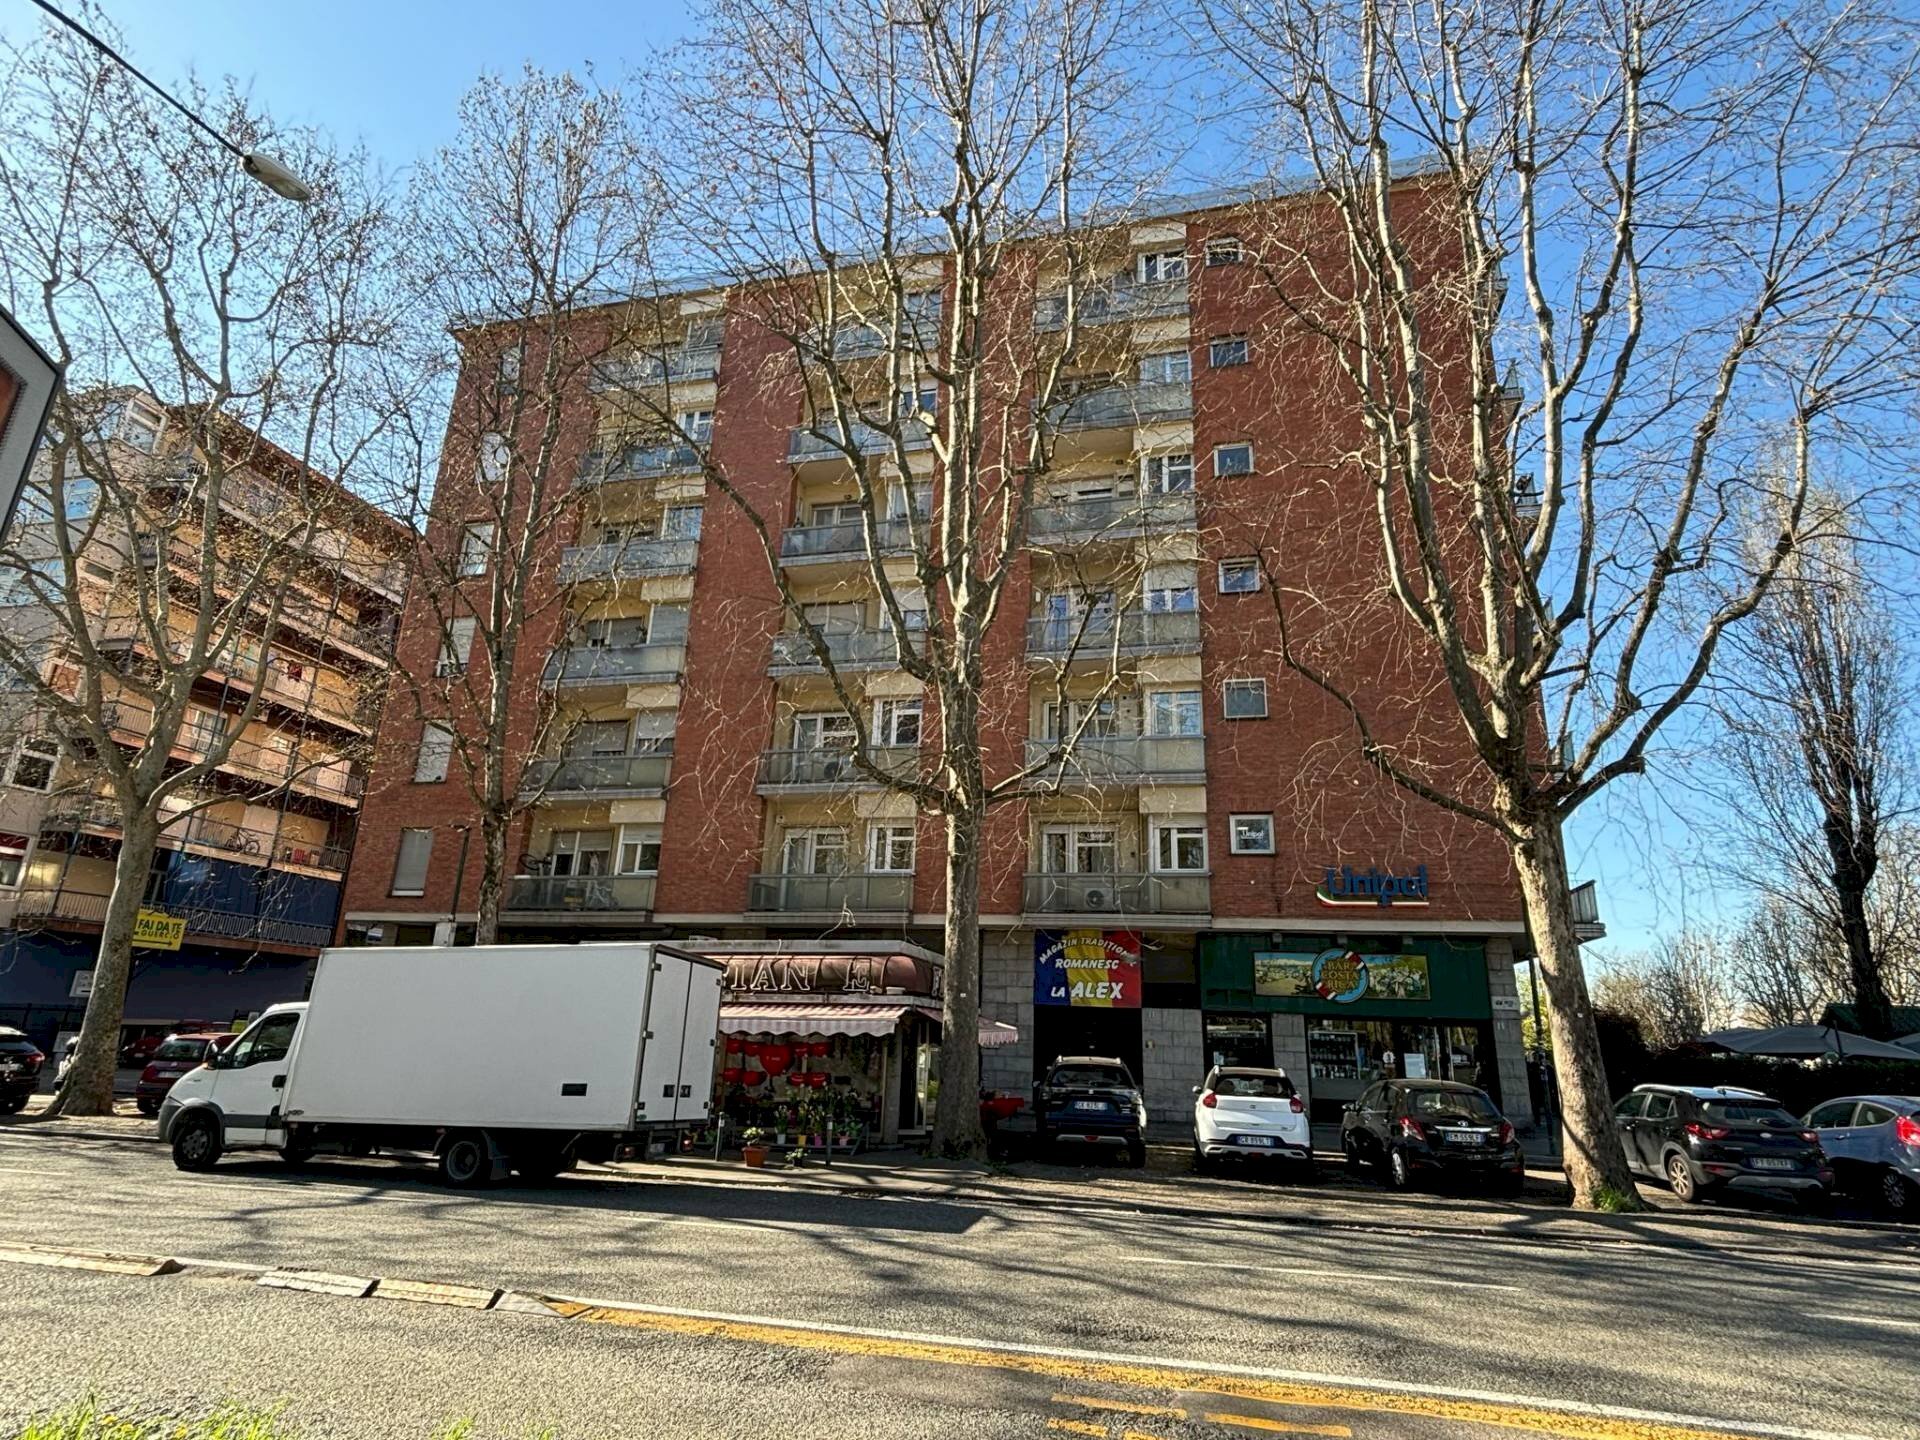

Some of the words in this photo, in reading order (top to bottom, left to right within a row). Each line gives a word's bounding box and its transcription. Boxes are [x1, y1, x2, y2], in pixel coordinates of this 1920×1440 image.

[1327, 864, 1428, 907] Unipol
[1039, 938, 1078, 965] MAGAZIN
[1055, 958, 1120, 970] ROMANESC
[1327, 960, 1350, 970] BAR
[1051, 986, 1066, 998] LA
[1070, 981, 1124, 1000] ALEX
